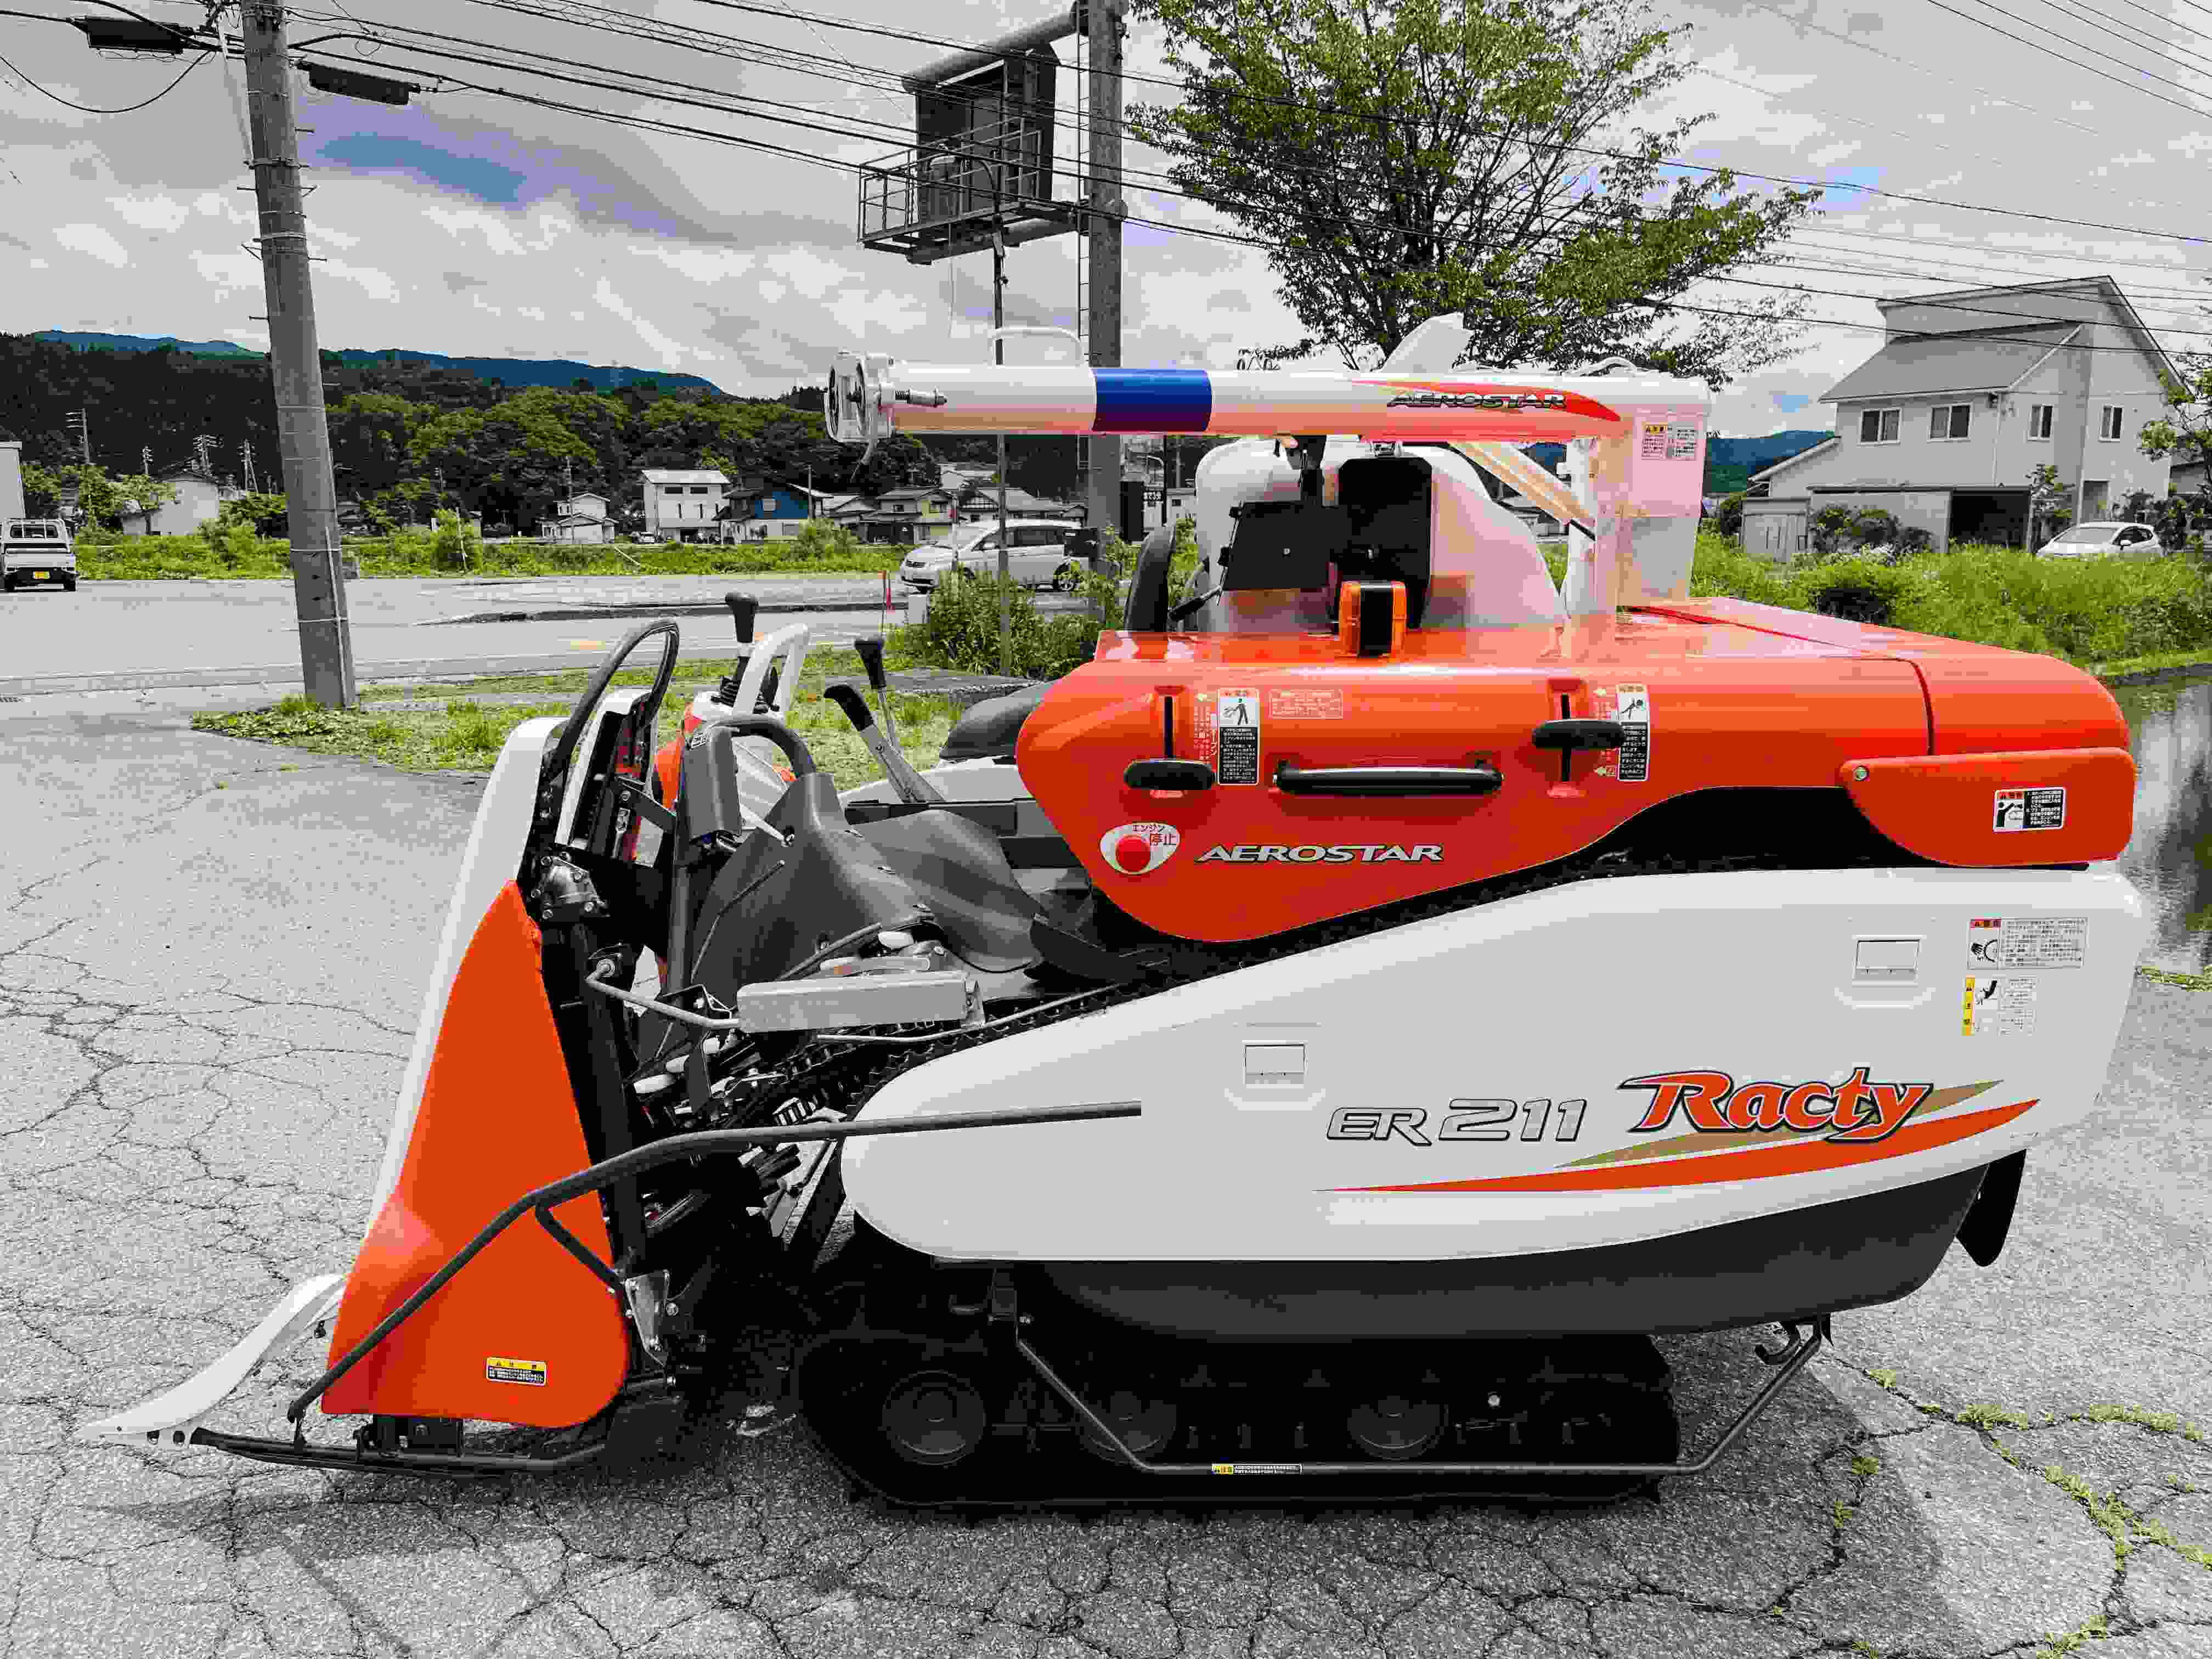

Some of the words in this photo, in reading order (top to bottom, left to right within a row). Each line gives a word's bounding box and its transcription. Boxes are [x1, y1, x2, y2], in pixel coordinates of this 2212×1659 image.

[1387, 391, 1567, 408] AEROSTAR
[1196, 843, 1445, 864] AEROSTAR
[1616, 1067, 1933, 1142] Racty
[1327, 1107, 1432, 1146] ER
[1438, 1098, 1587, 1142] 211
